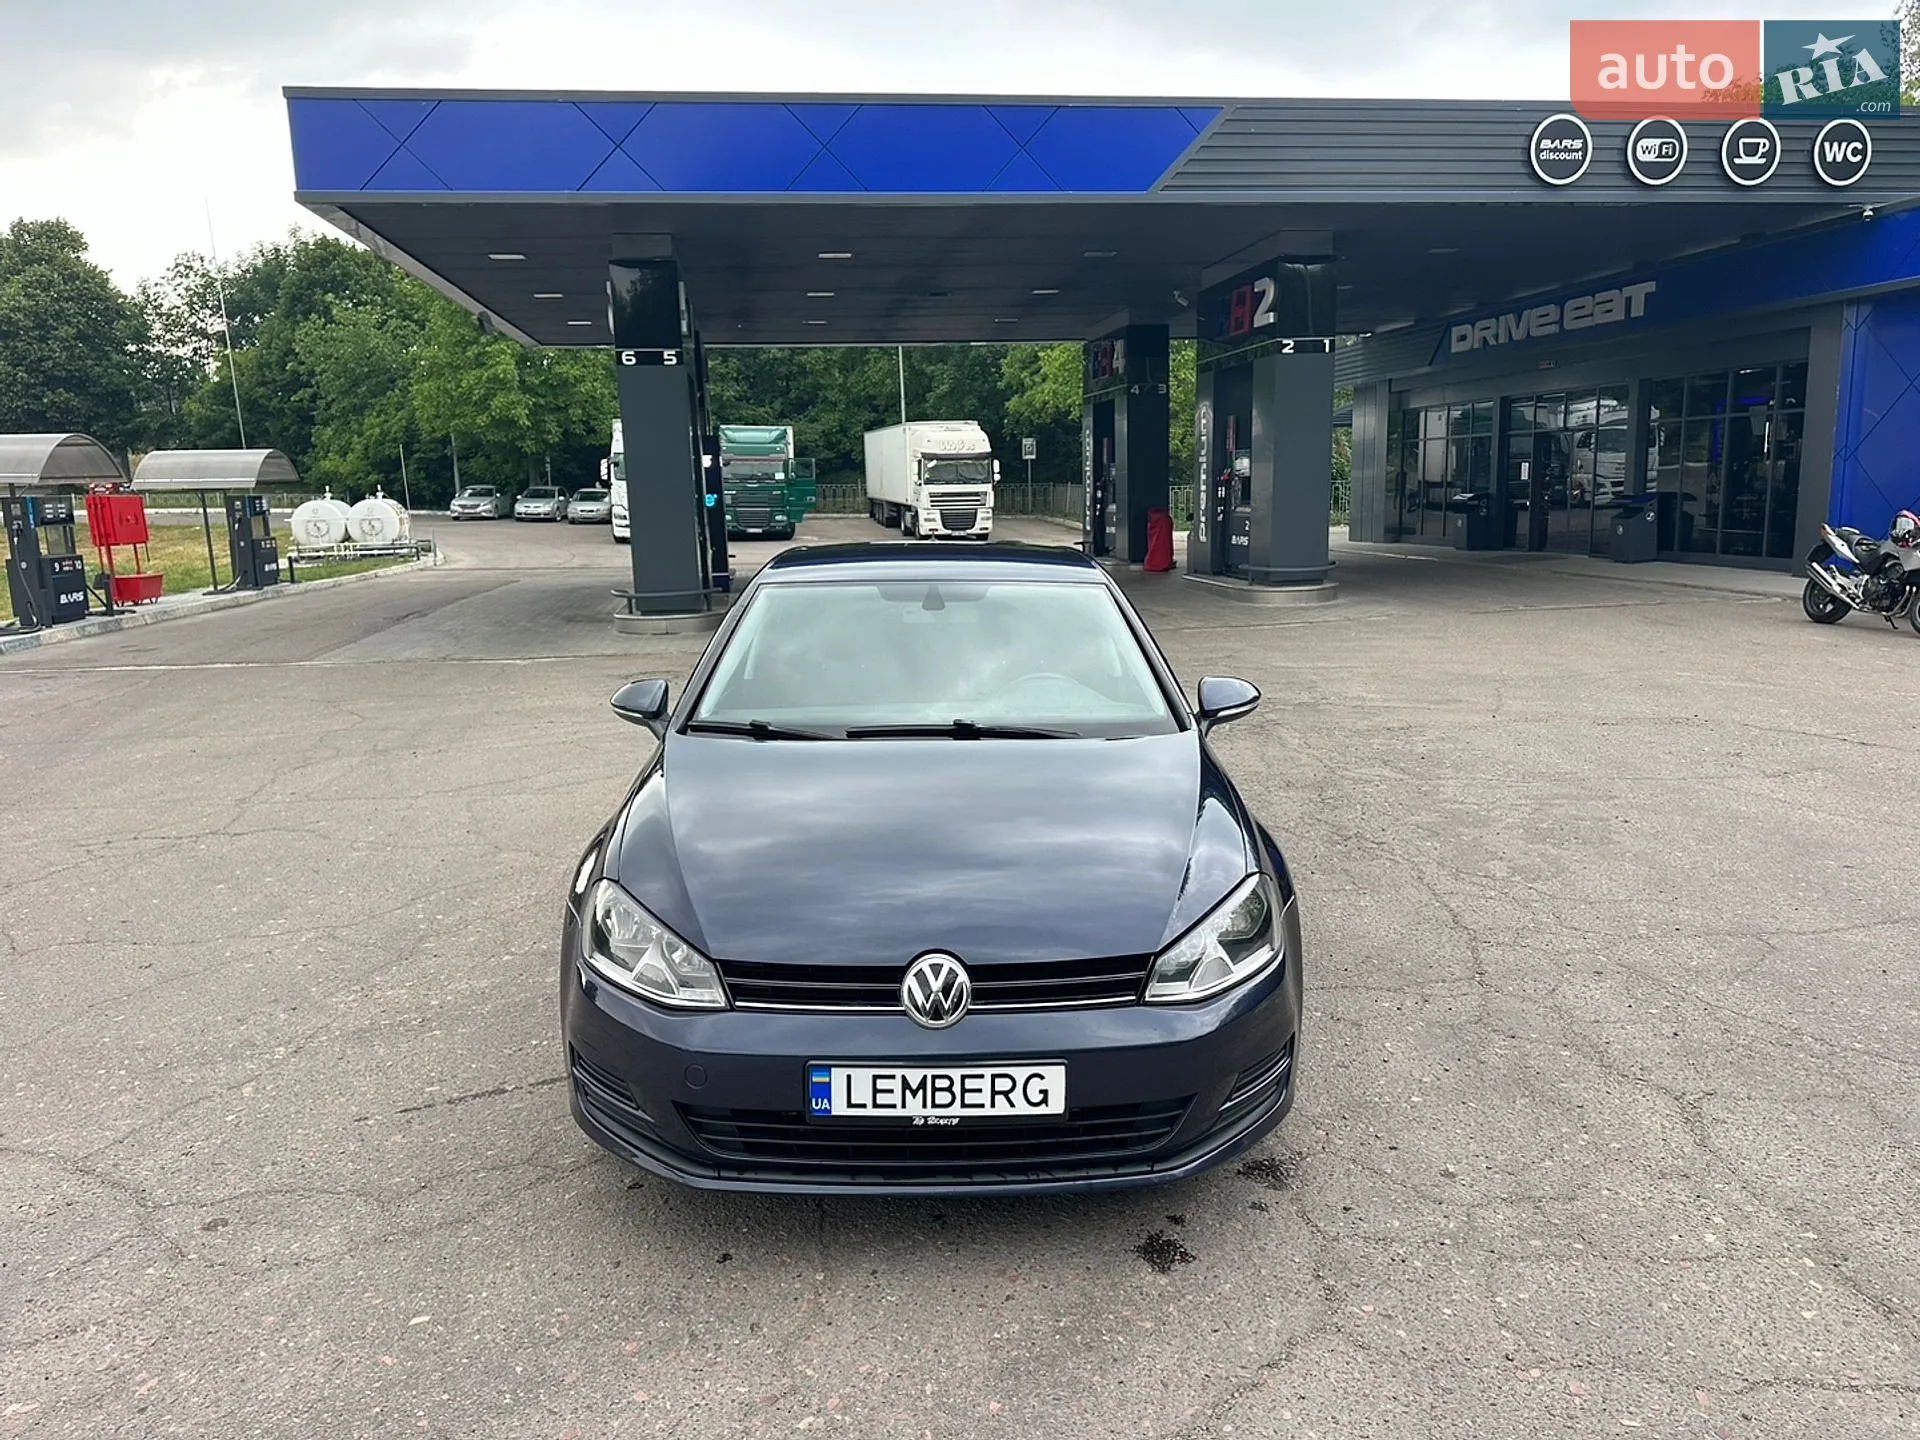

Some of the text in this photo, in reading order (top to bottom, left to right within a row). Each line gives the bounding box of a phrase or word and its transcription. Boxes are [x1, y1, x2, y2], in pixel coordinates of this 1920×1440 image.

[1539, 138, 1584, 149] BARS
[1539, 150, 1583, 160] discount
[1823, 141, 1863, 163] WC
[1253, 276, 1275, 328] 2
[1281, 339, 1331, 354] 2 1
[621, 350, 678, 365] 6 5
[1130, 383, 1167, 395] 4 3
[812, 1072, 1050, 1110] UA LEMBERG
